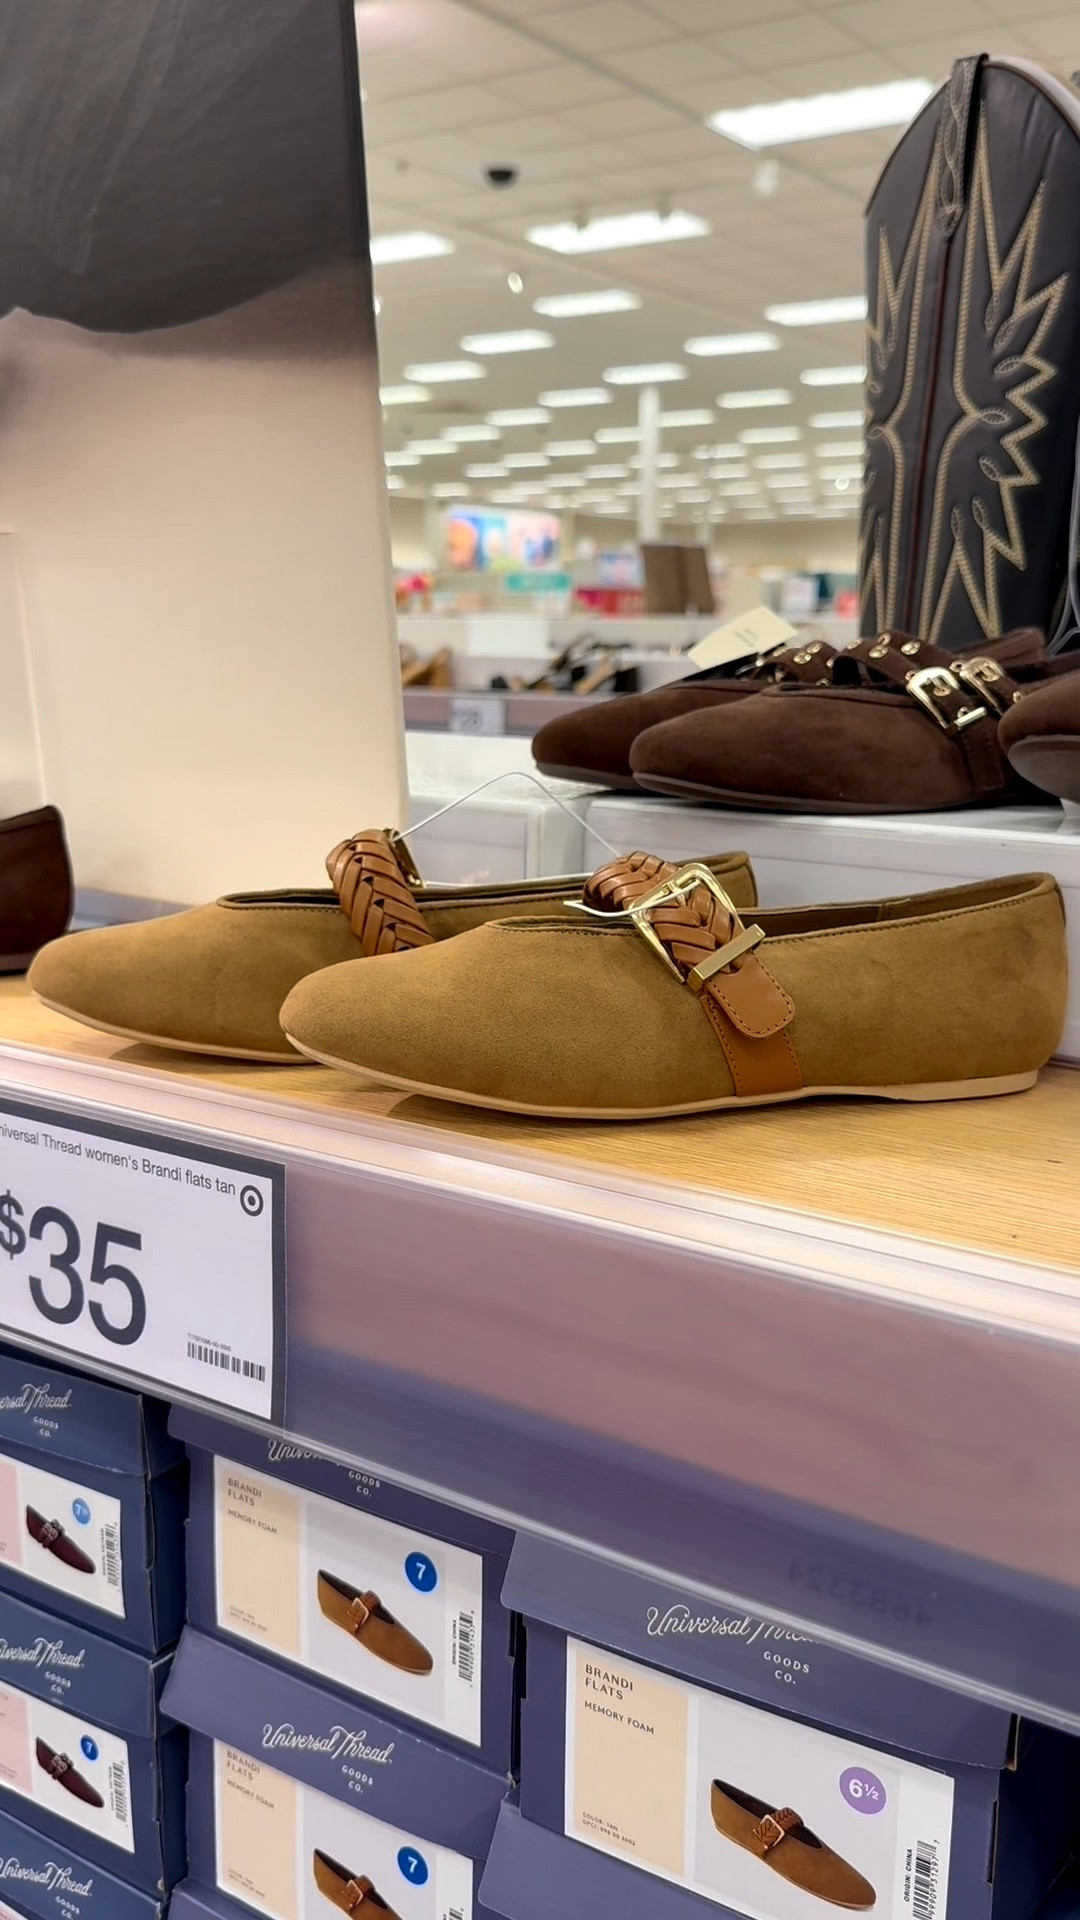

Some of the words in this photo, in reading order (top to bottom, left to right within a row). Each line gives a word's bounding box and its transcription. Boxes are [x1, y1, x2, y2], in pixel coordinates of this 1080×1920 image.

[42, 1133, 82, 1156] Thread
[85, 1147, 139, 1171] women's
[142, 1158, 182, 1182] Brandi
[185, 1169, 212, 1190] flats
[215, 1177, 236, 1196] tan
[0, 1189, 147, 1346] $35
[228, 1477, 262, 1498] BRANDI
[348, 1470, 381, 1488] GOODS
[228, 1489, 255, 1507] FLATS
[356, 1485, 372, 1497] CO.
[228, 1509, 255, 1525] MEMORY
[258, 1521, 277, 1534] FOAM
[416, 1561, 426, 1580] 7
[646, 1604, 752, 1637] Universal
[763, 1650, 811, 1674] GOODS
[585, 1663, 633, 1691] BRANDI
[585, 1677, 623, 1700] FLATS
[774, 1669, 797, 1685] CO.
[584, 1700, 625, 1722] MEMORY
[627, 1717, 655, 1735] FOAM
[262, 1723, 340, 1752] Universal
[227, 1749, 260, 1773] BRANDI
[227, 1760, 254, 1781] FLATS
[342, 1765, 374, 1786] GOODS
[348, 1780, 364, 1793] CO.
[408, 1855, 418, 1874] 7
[905, 1848, 913, 1872] CHINA
[903, 1874, 911, 1903] ORIGIN:
